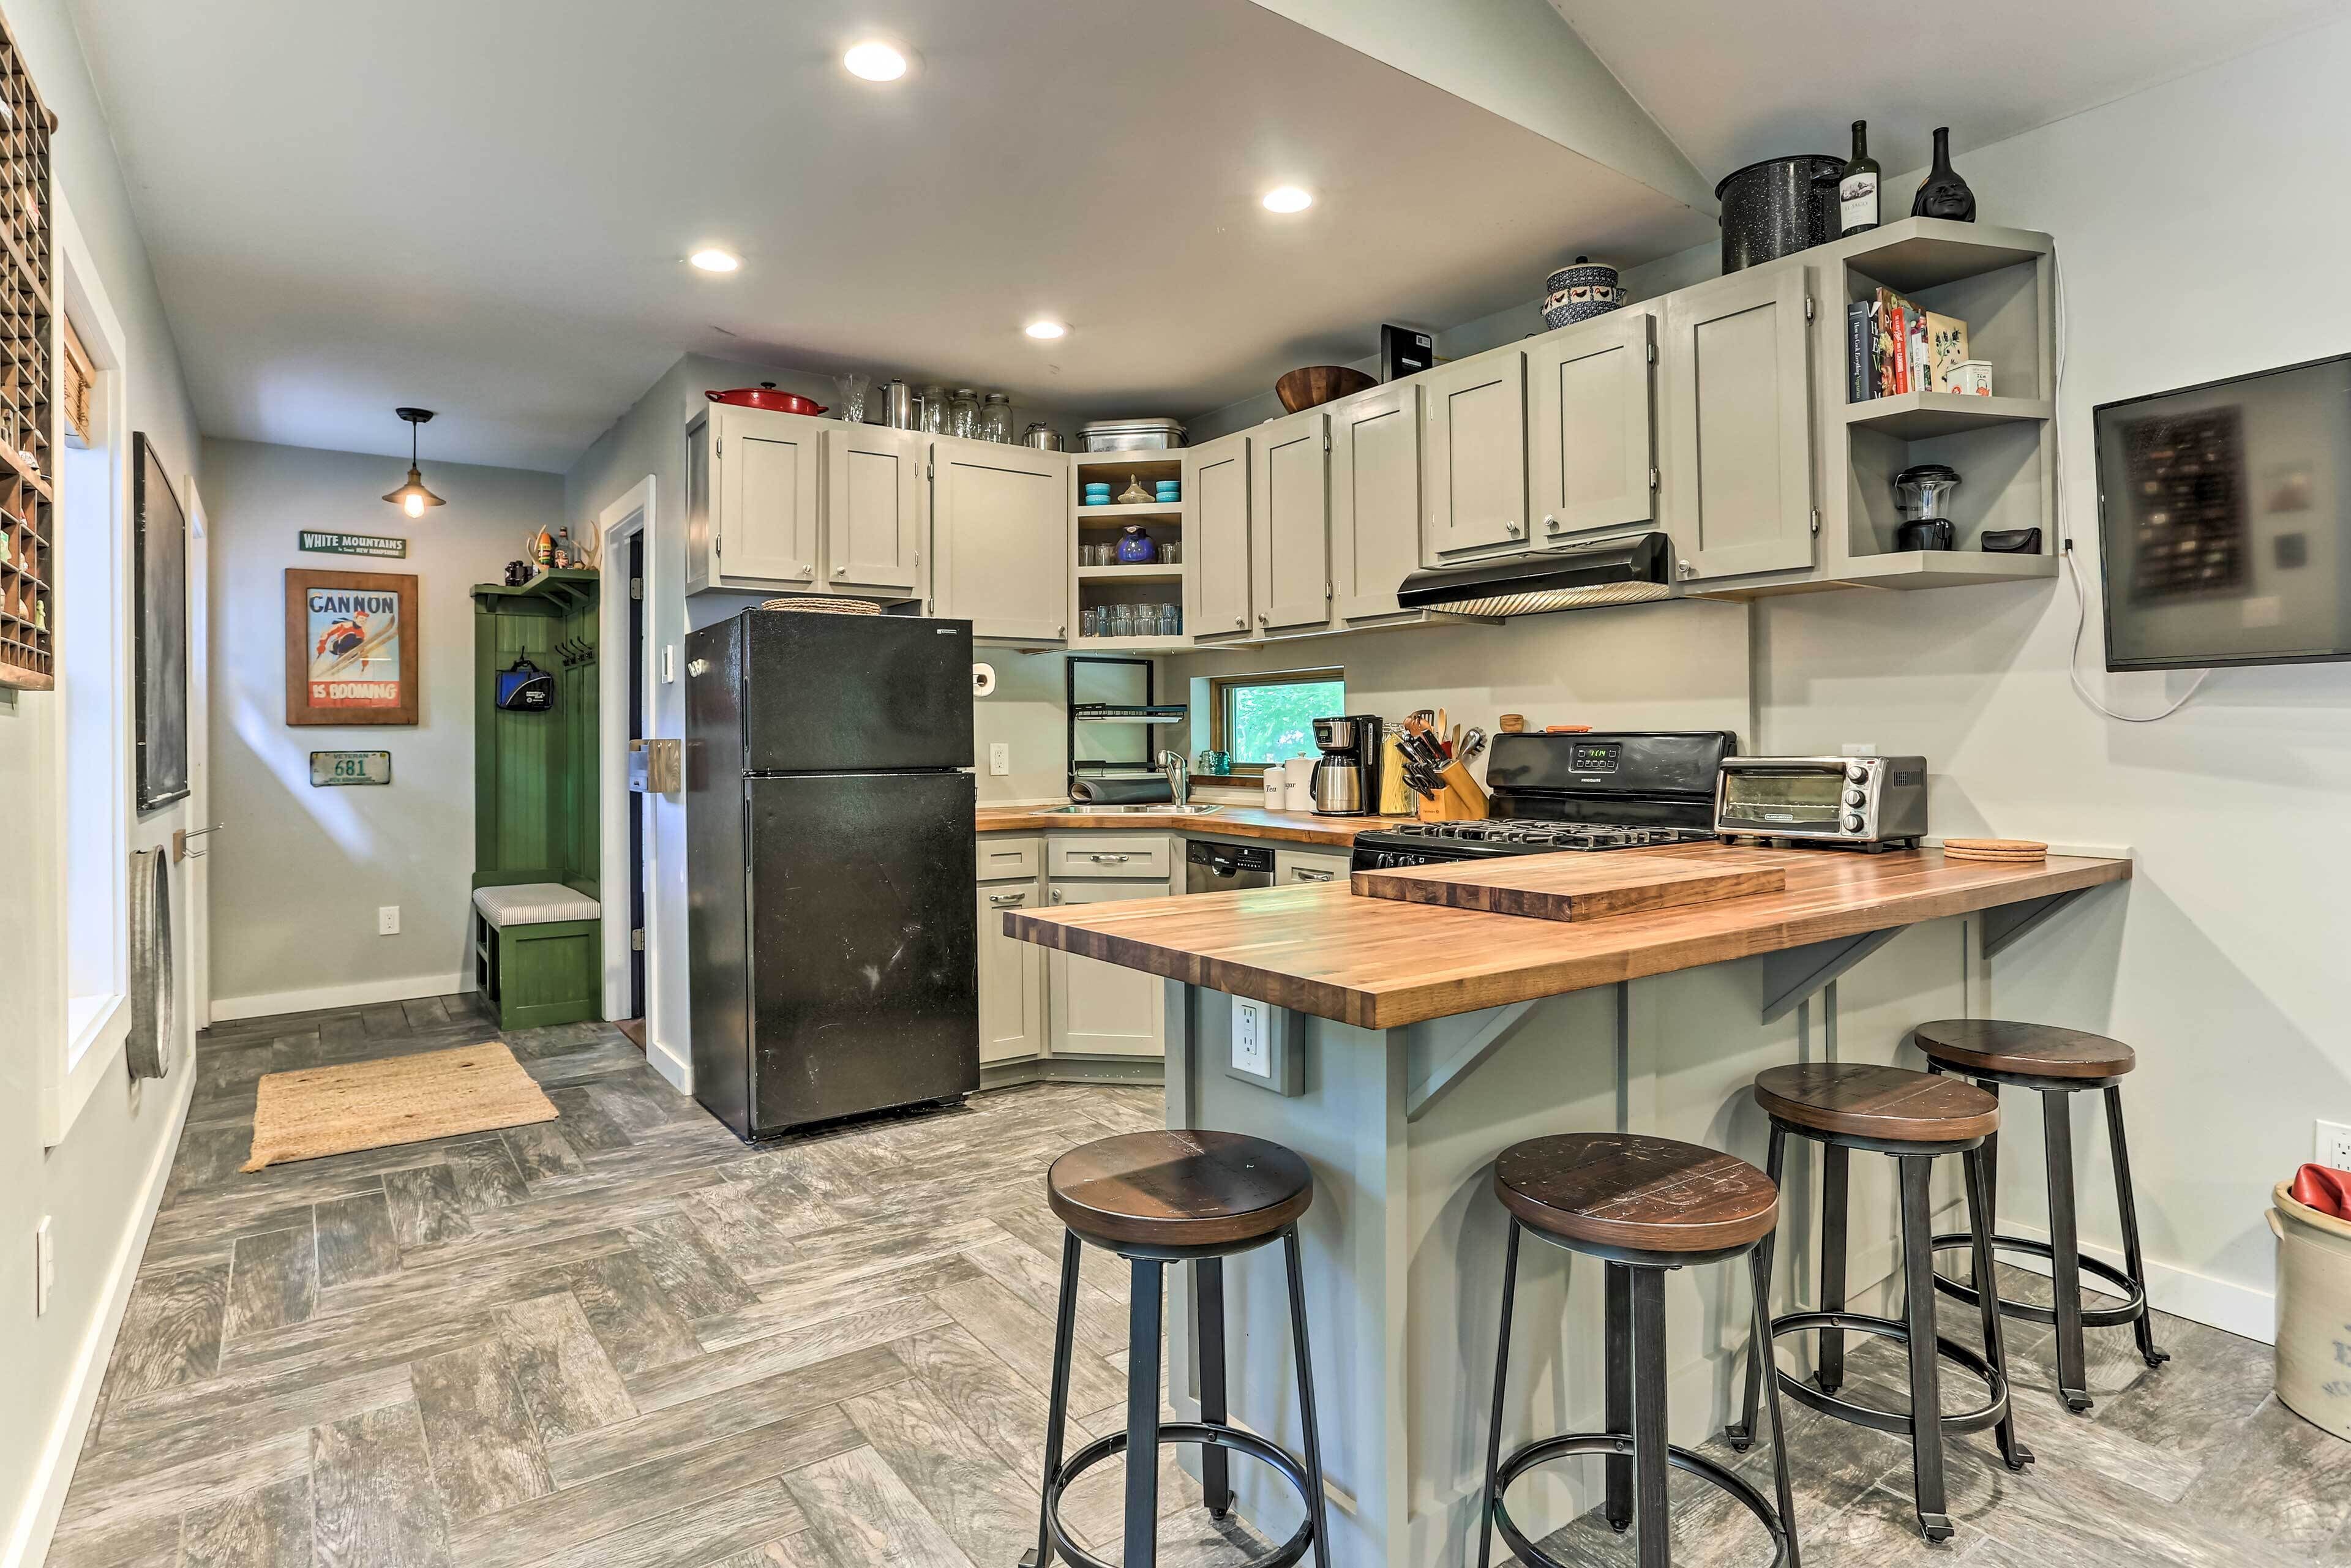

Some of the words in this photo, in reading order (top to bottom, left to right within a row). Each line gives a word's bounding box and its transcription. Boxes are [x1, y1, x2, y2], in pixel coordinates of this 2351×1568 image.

[304, 533, 339, 549] WHITE
[342, 536, 402, 550] MOUNTAINS
[309, 594, 394, 613] CANNON
[313, 684, 326, 698] IS
[329, 683, 397, 699] BOOMING
[335, 760, 366, 776] 681
